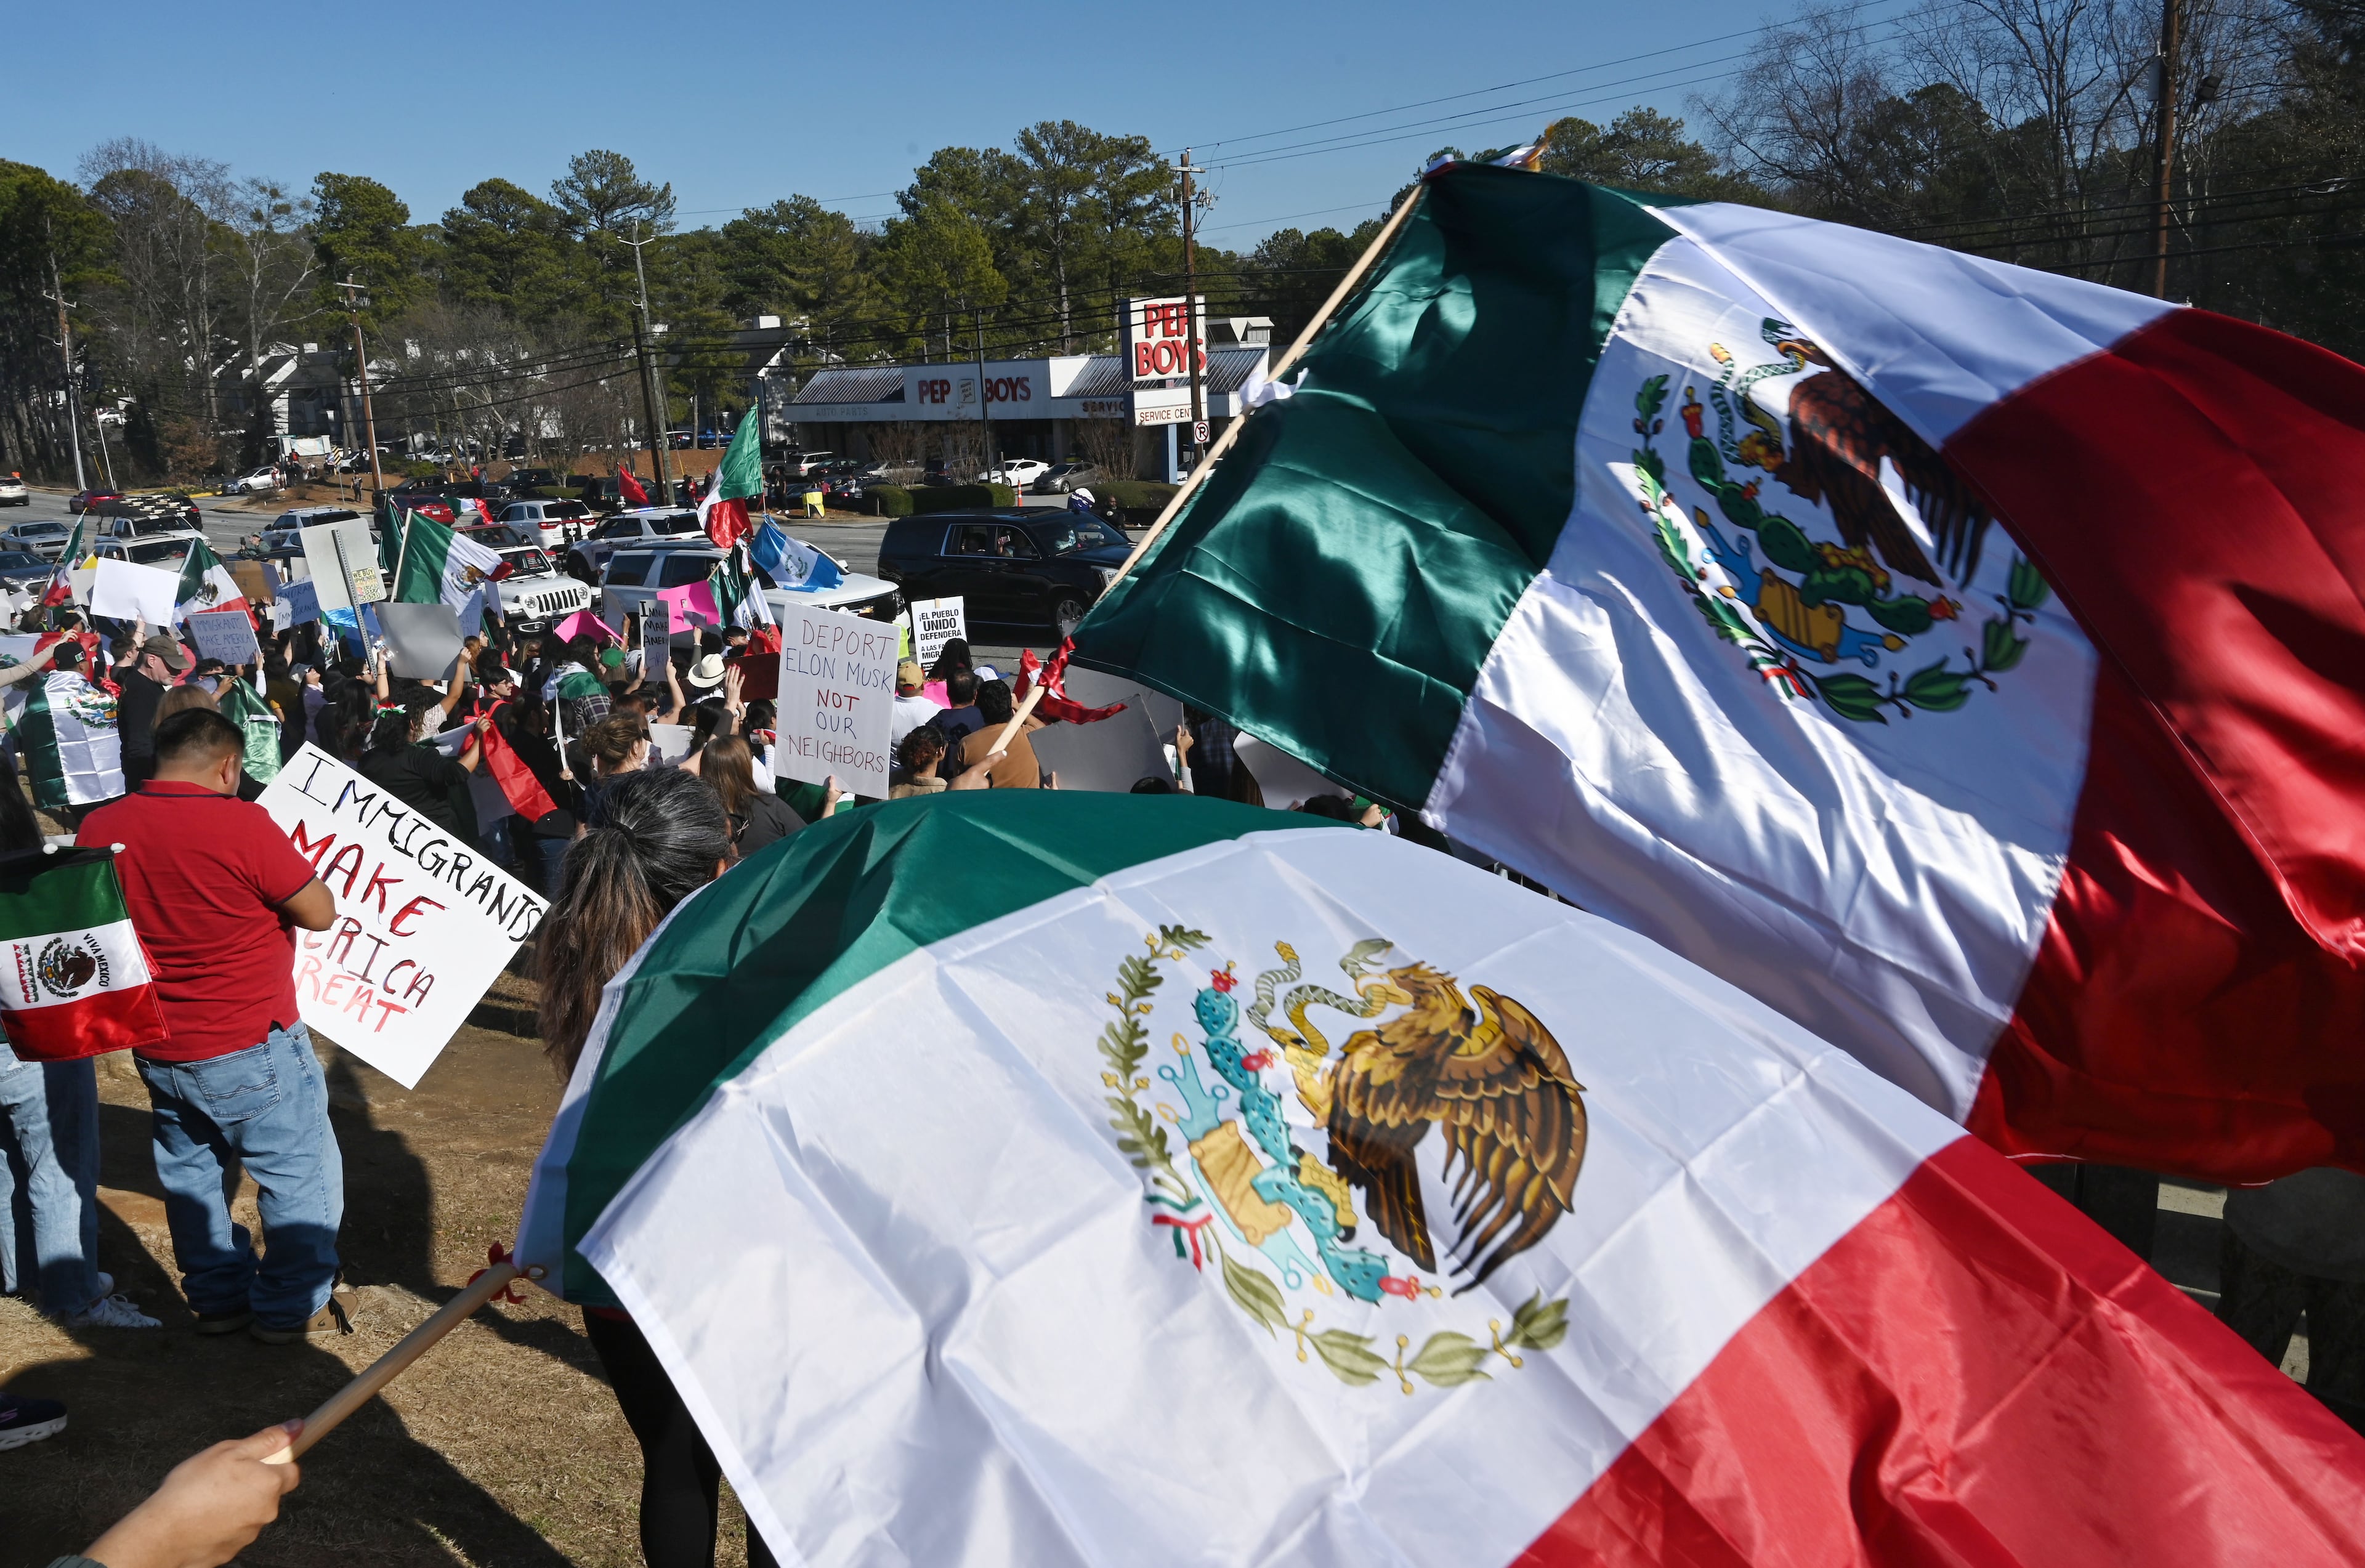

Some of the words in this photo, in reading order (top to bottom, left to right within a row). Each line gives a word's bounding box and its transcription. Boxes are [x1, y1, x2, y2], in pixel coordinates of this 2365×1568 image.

[1135, 338, 1206, 377] BOYS
[918, 379, 951, 404] PEP
[985, 377, 1031, 402] BOYS
[817, 407, 836, 416] AUTO
[840, 406, 868, 416] PARTS
[1082, 400, 1125, 413] SERVIC
[1139, 410, 1171, 422] SERVICE
[1174, 407, 1192, 418] CENT
[362, 568, 373, 576] BUY
[277, 584, 313, 606] IGNORAN
[361, 592, 380, 602] 5658
[278, 601, 318, 625] IMMIGRANTS
[919, 613, 930, 621] ¡EL
[932, 608, 959, 619] PUEBLO
[195, 618, 243, 632] IMMIGRANTS
[644, 620, 668, 632] MAKE
[921, 628, 962, 641] DEFENDERÁ
[923, 618, 956, 631] UNIDO
[199, 635, 222, 646] MAKE
[223, 633, 251, 645] AMERICA
[802, 620, 894, 660] DEPORT
[786, 647, 836, 679] ELON
[847, 661, 892, 693] MUSK
[817, 689, 860, 711] NOT
[816, 711, 857, 739] OUR
[788, 735, 885, 772] NEIGHBORS
[289, 752, 543, 942] IMMIGRANTS
[290, 819, 450, 937] MAKE
[83, 933, 102, 954] VIVA
[95, 955, 110, 987] MEXICO
[303, 914, 435, 1008] ERICA
[295, 955, 413, 1033] REAT
